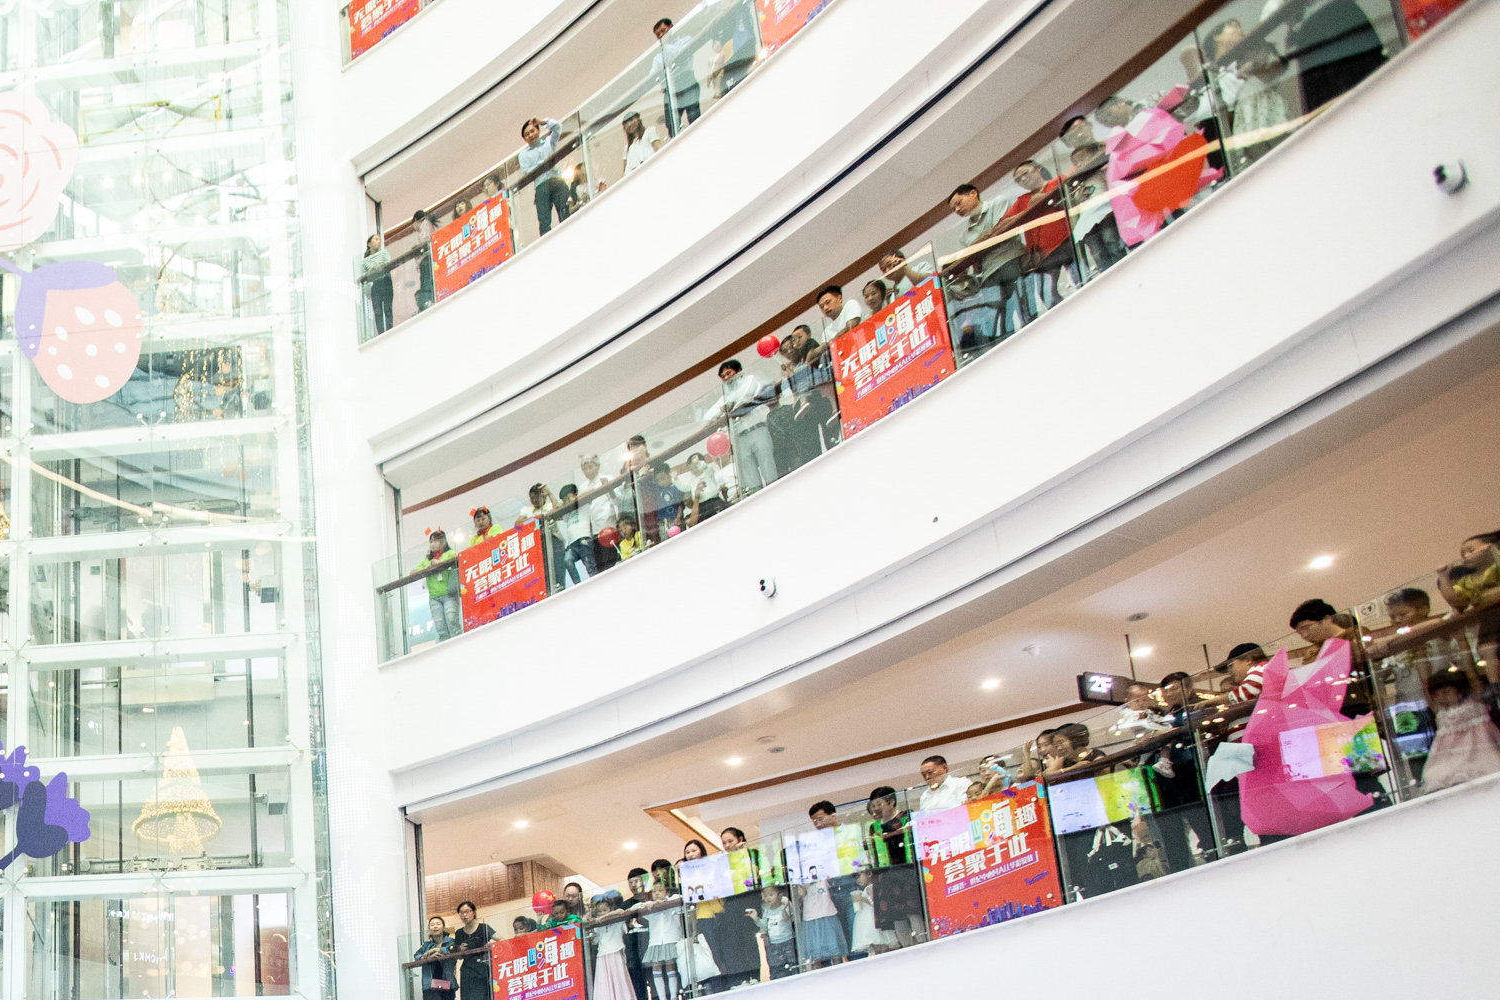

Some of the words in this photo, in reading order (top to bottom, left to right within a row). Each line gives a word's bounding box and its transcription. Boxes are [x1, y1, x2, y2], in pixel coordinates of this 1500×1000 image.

[853, 322, 930, 390] 荟聚于此
[1090, 675, 1113, 693] 2F
[943, 832, 1031, 884] 荟聚于此
[507, 962, 569, 995] 荟聚于此
